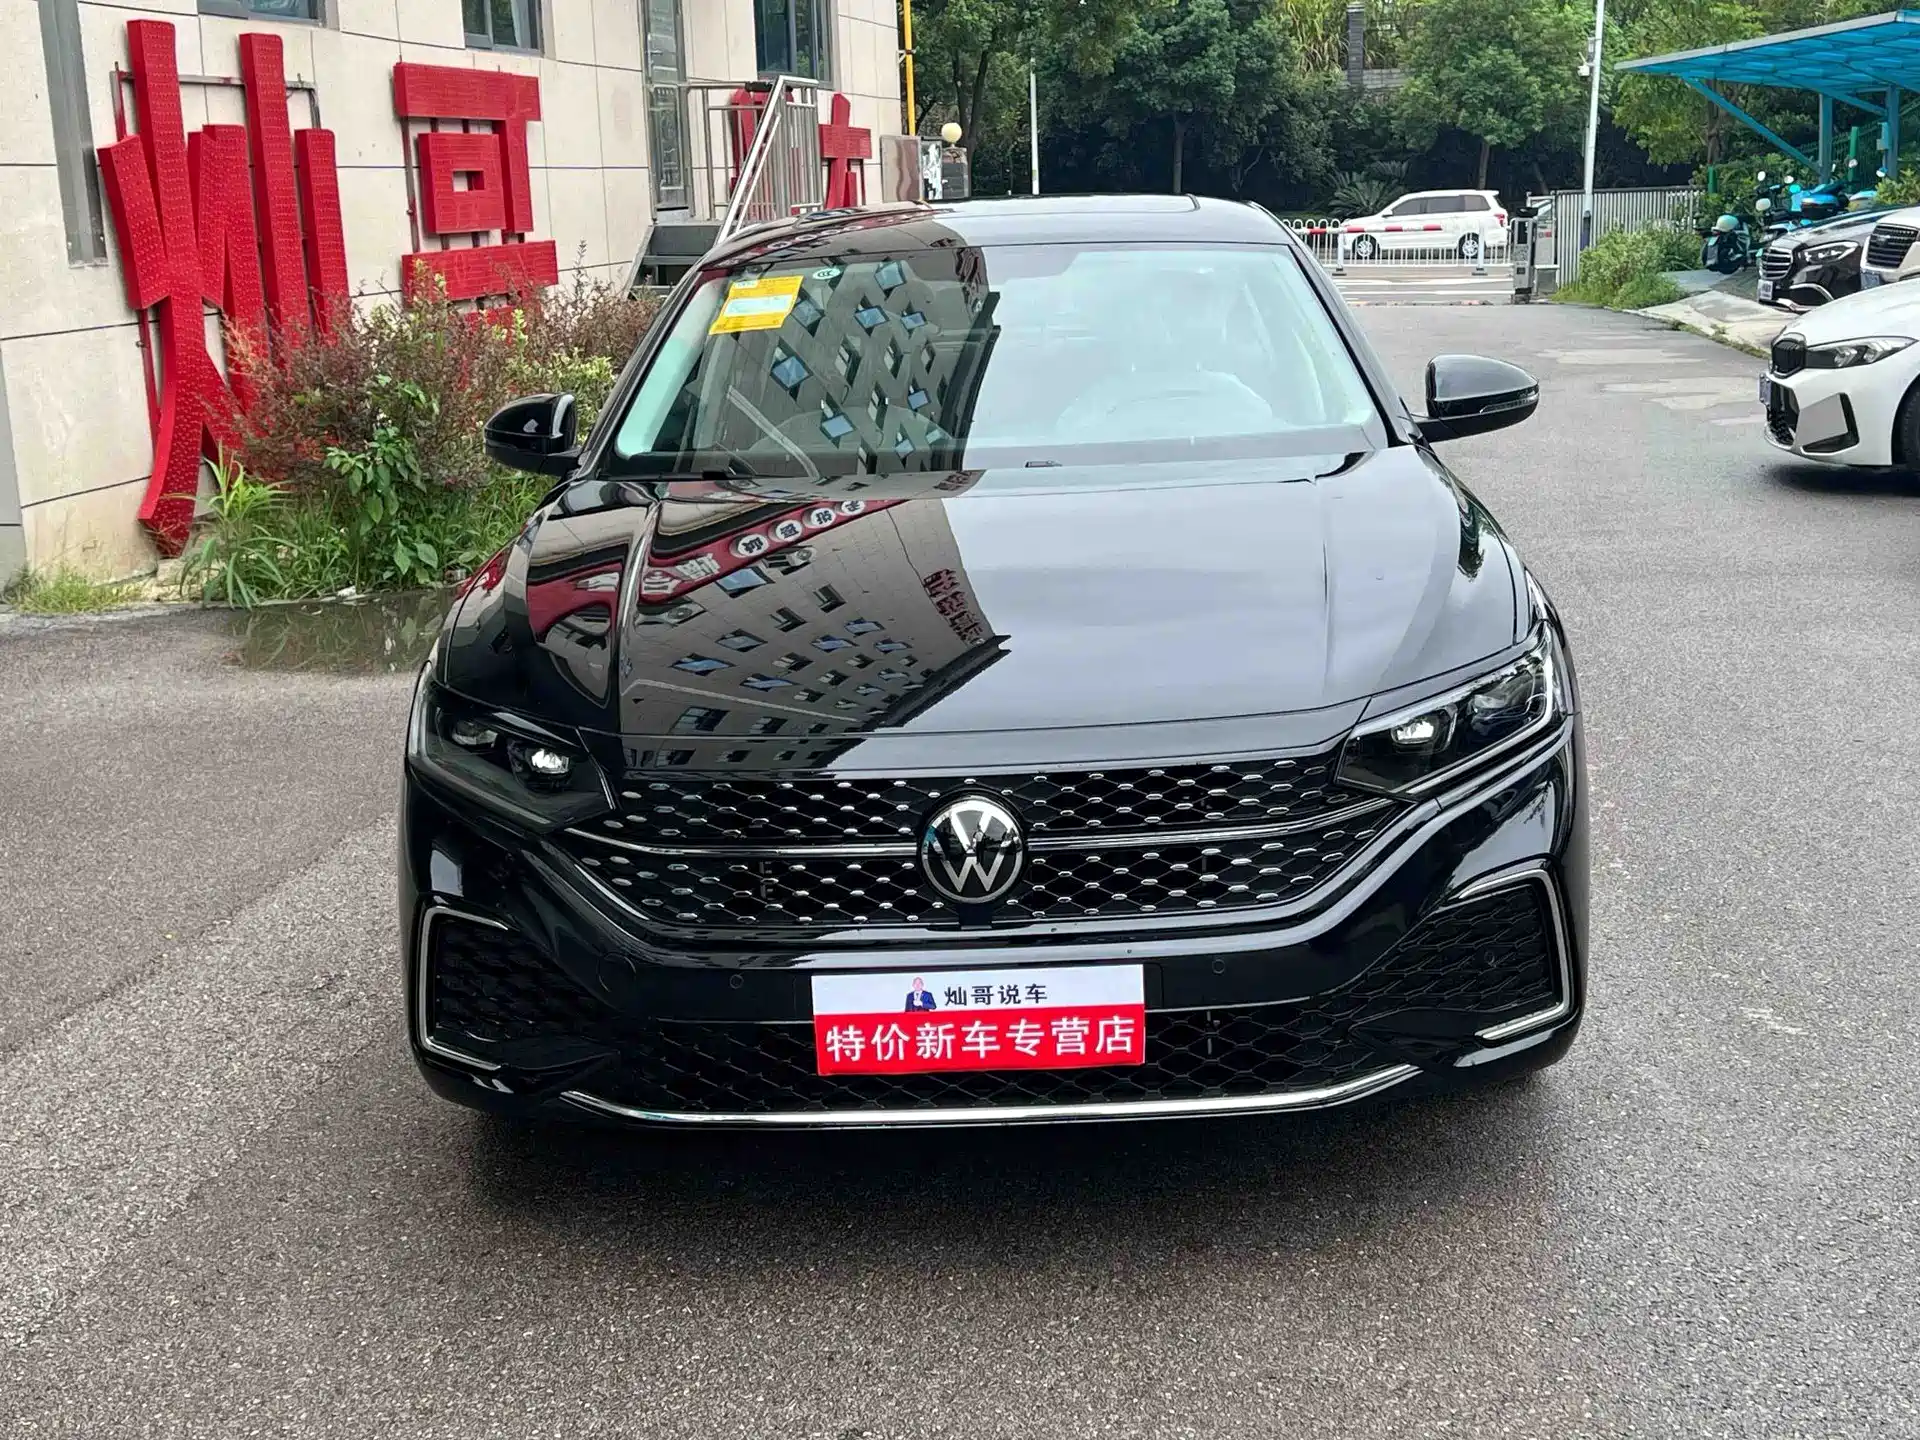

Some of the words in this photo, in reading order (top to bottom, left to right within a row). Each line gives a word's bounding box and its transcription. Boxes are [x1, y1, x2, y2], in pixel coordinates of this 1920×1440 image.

[944, 983, 1048, 1006] 灿哥说车
[825, 1014, 1135, 1063] 特价新车专营店
